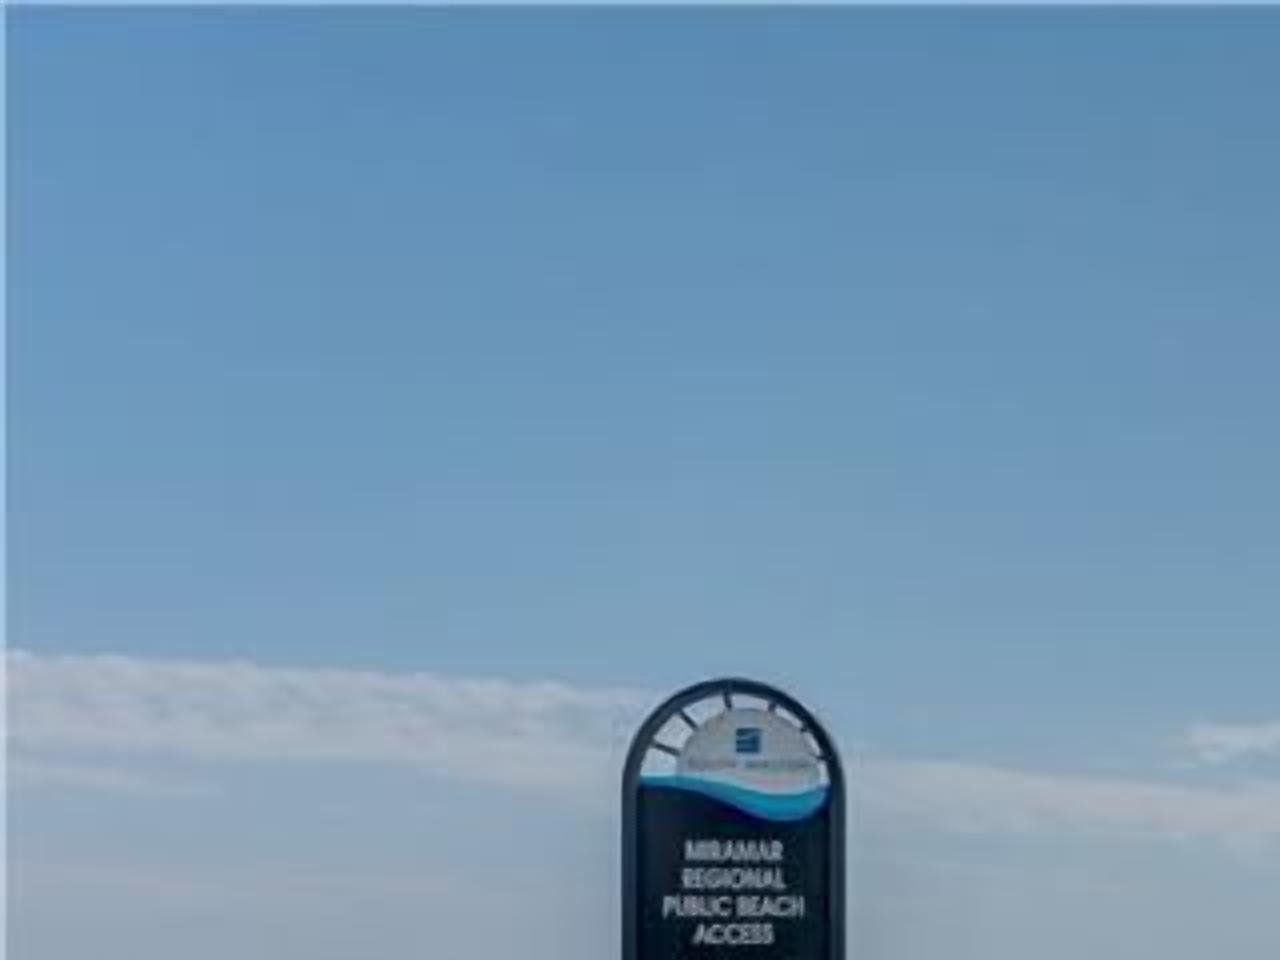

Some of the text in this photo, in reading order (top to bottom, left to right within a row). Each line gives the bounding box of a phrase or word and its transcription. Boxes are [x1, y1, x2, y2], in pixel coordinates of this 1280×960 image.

[684, 840, 784, 861] MIRAMAR
[682, 868, 786, 889] REGIONAL
[662, 896, 805, 918] PUBLIC BEACH
[692, 924, 774, 944] ACCESS
